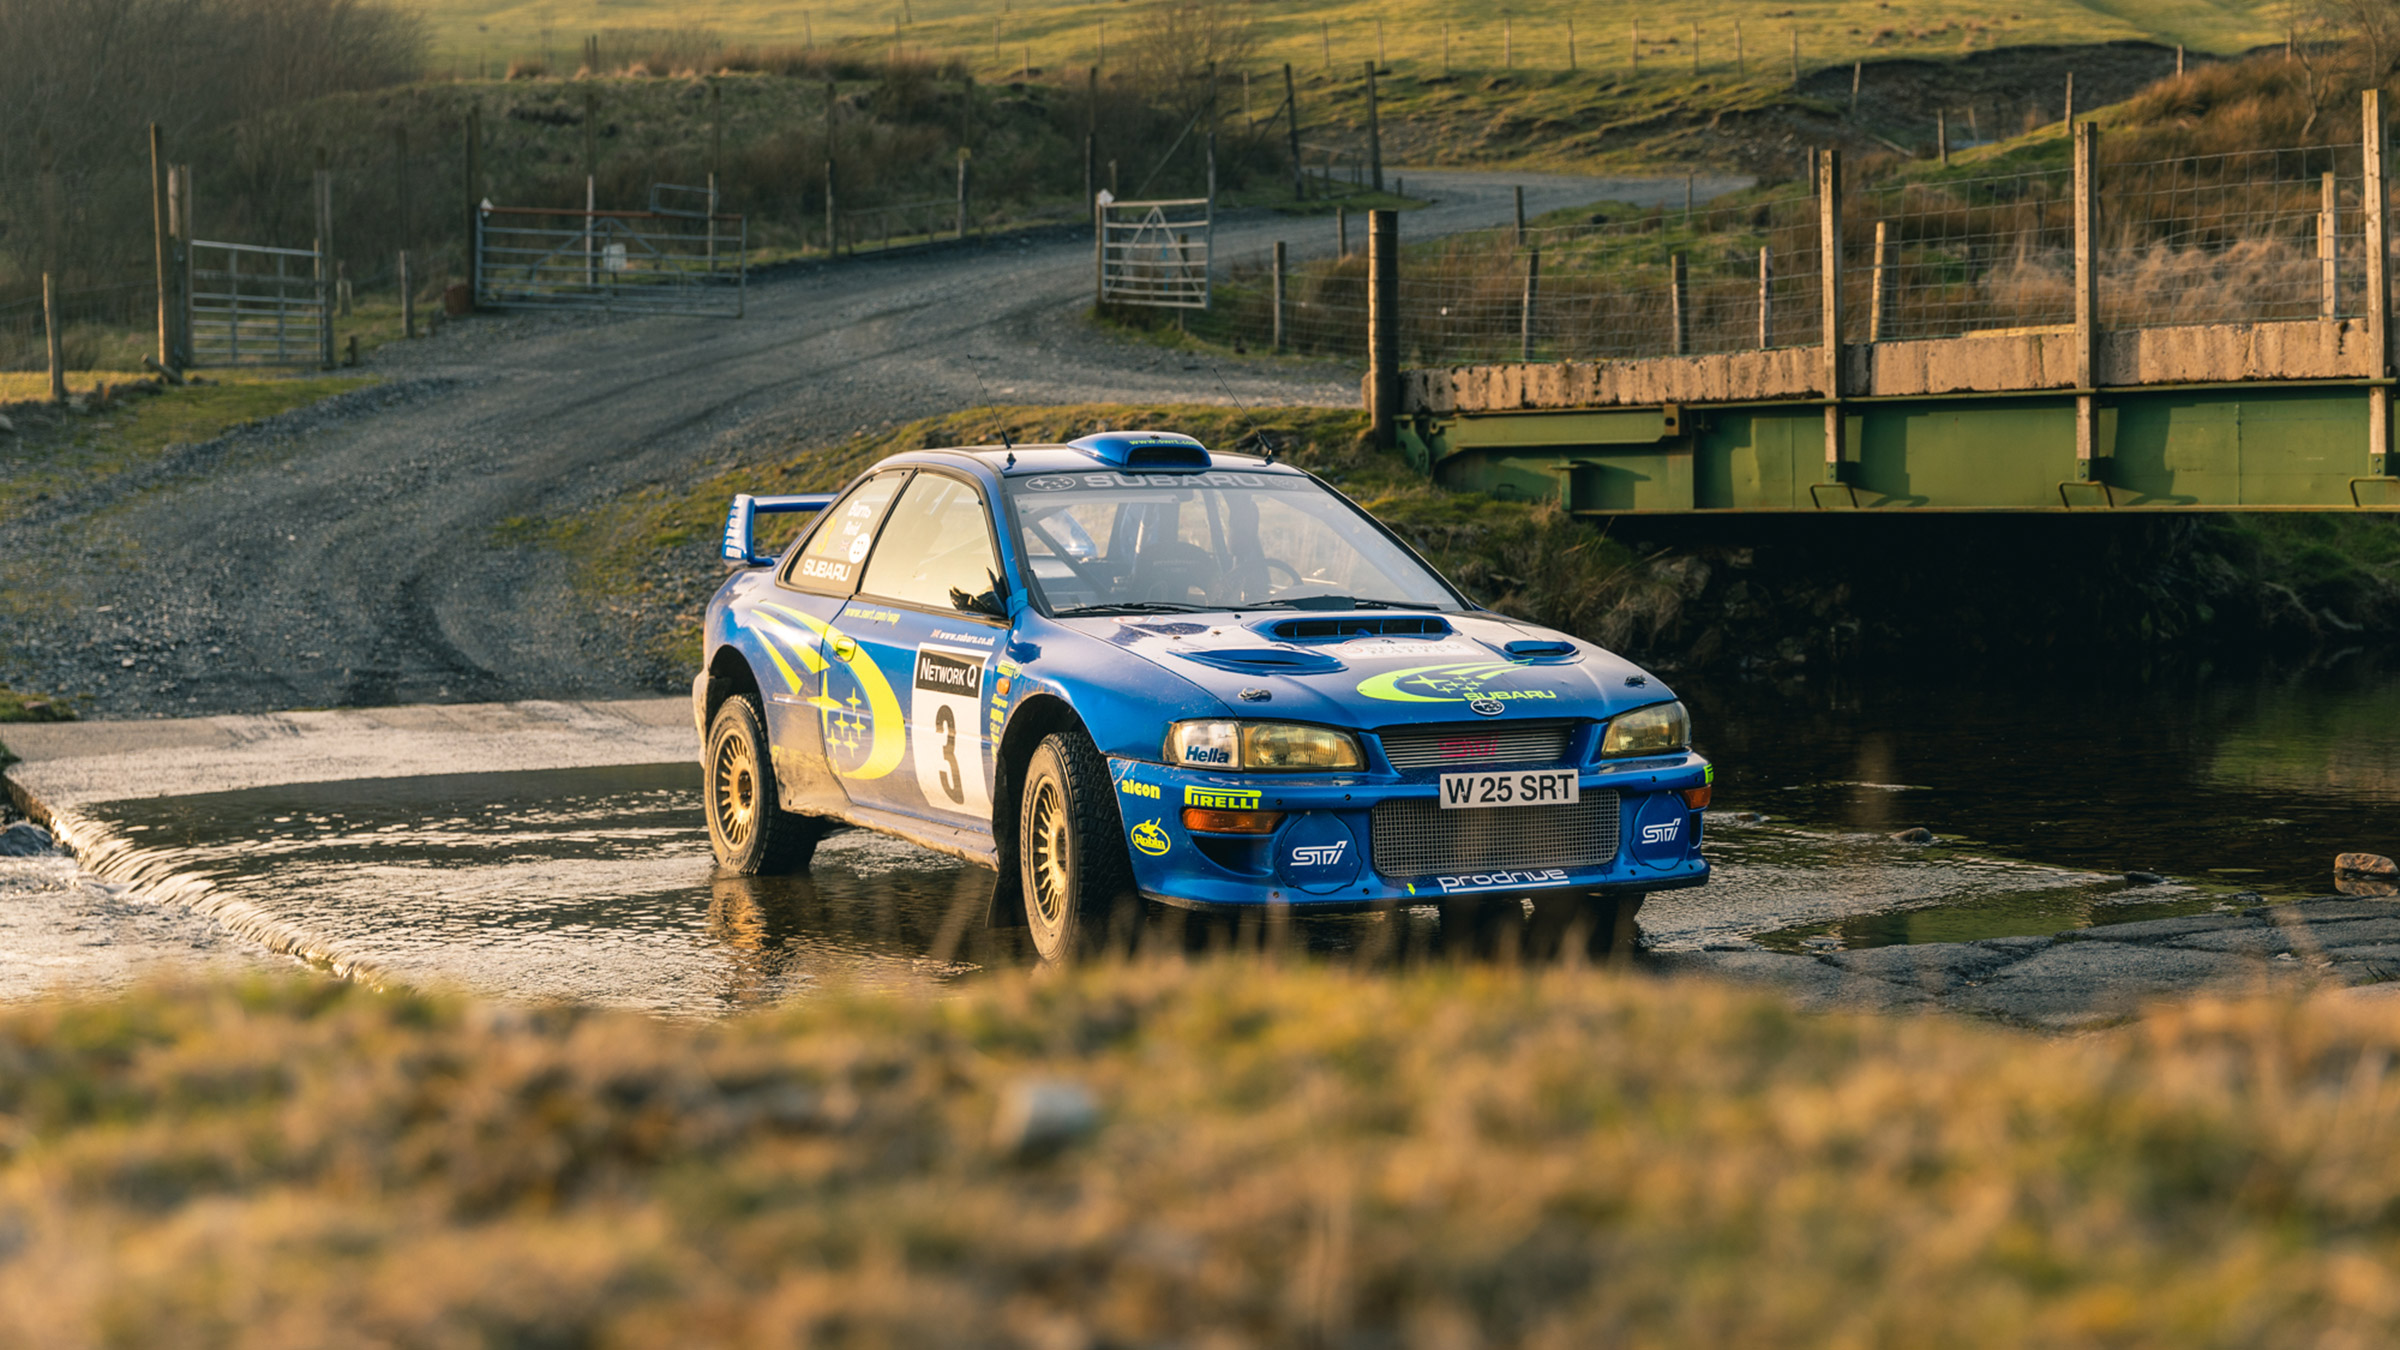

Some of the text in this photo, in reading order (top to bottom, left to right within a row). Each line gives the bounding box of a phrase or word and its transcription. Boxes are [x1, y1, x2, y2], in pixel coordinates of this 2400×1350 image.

[1083, 474, 1265, 488] SUBARU
[802, 559, 852, 582] SUBARU
[966, 664, 977, 688] Q
[1463, 690, 1557, 701] SUBARU
[936, 704, 965, 805] 3
[1185, 745, 1230, 763] Hella
[1121, 779, 1161, 799] alcon
[1184, 785, 1262, 810] PIRELLI
[1445, 774, 1575, 803] W 25 SRT
[1134, 833, 1166, 850] Robin
[1437, 869, 1569, 893] prodrive
